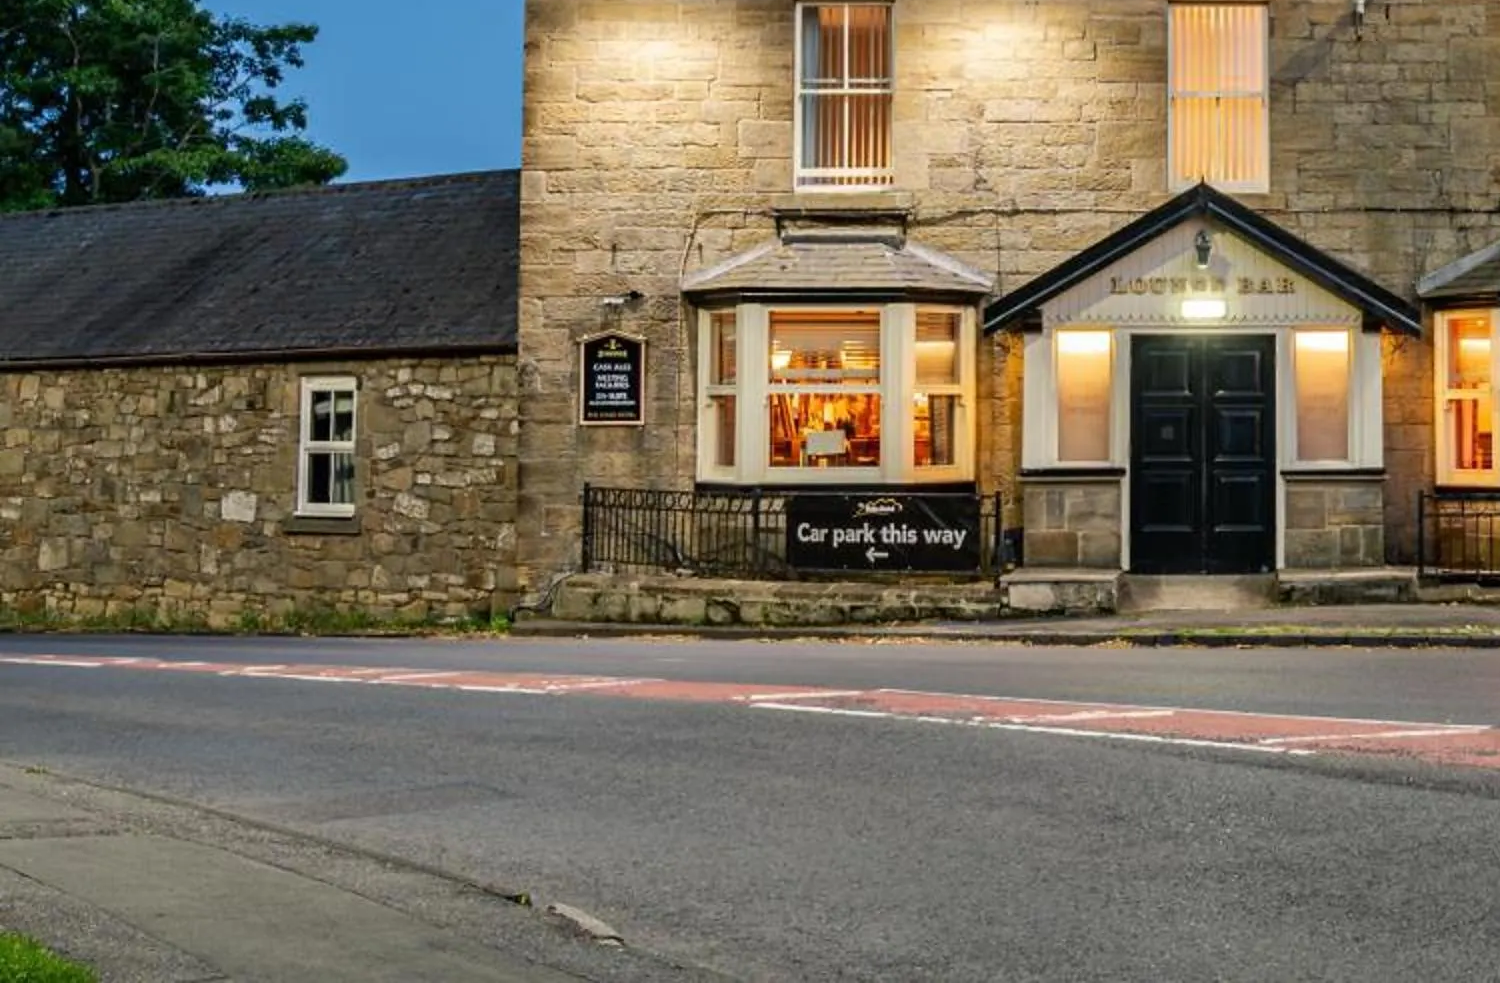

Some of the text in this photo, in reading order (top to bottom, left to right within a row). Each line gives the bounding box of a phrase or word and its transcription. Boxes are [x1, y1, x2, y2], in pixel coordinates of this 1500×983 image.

[1236, 276, 1296, 294] BAR
[797, 522, 967, 551] Car park this way
